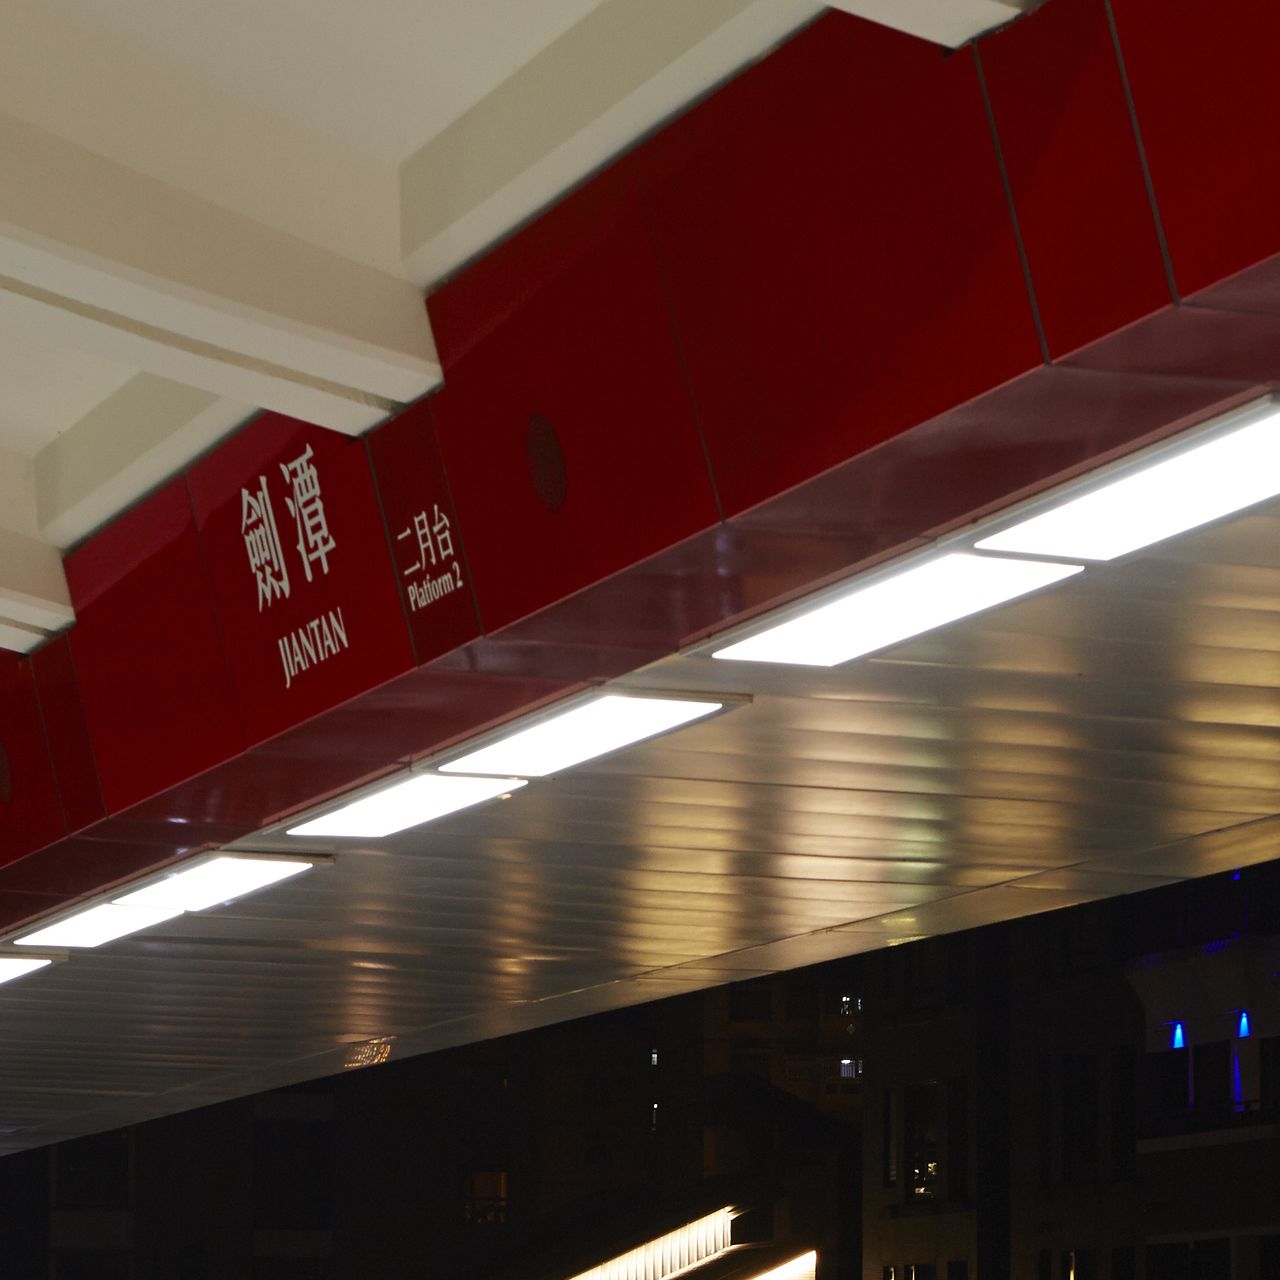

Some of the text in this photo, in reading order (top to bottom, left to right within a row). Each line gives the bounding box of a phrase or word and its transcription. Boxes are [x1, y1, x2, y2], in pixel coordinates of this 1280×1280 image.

[241, 443, 336, 612] 劍潭
[397, 504, 454, 576] 二月台
[407, 561, 463, 612] Platform 2
[278, 606, 349, 689] JIANTAN
